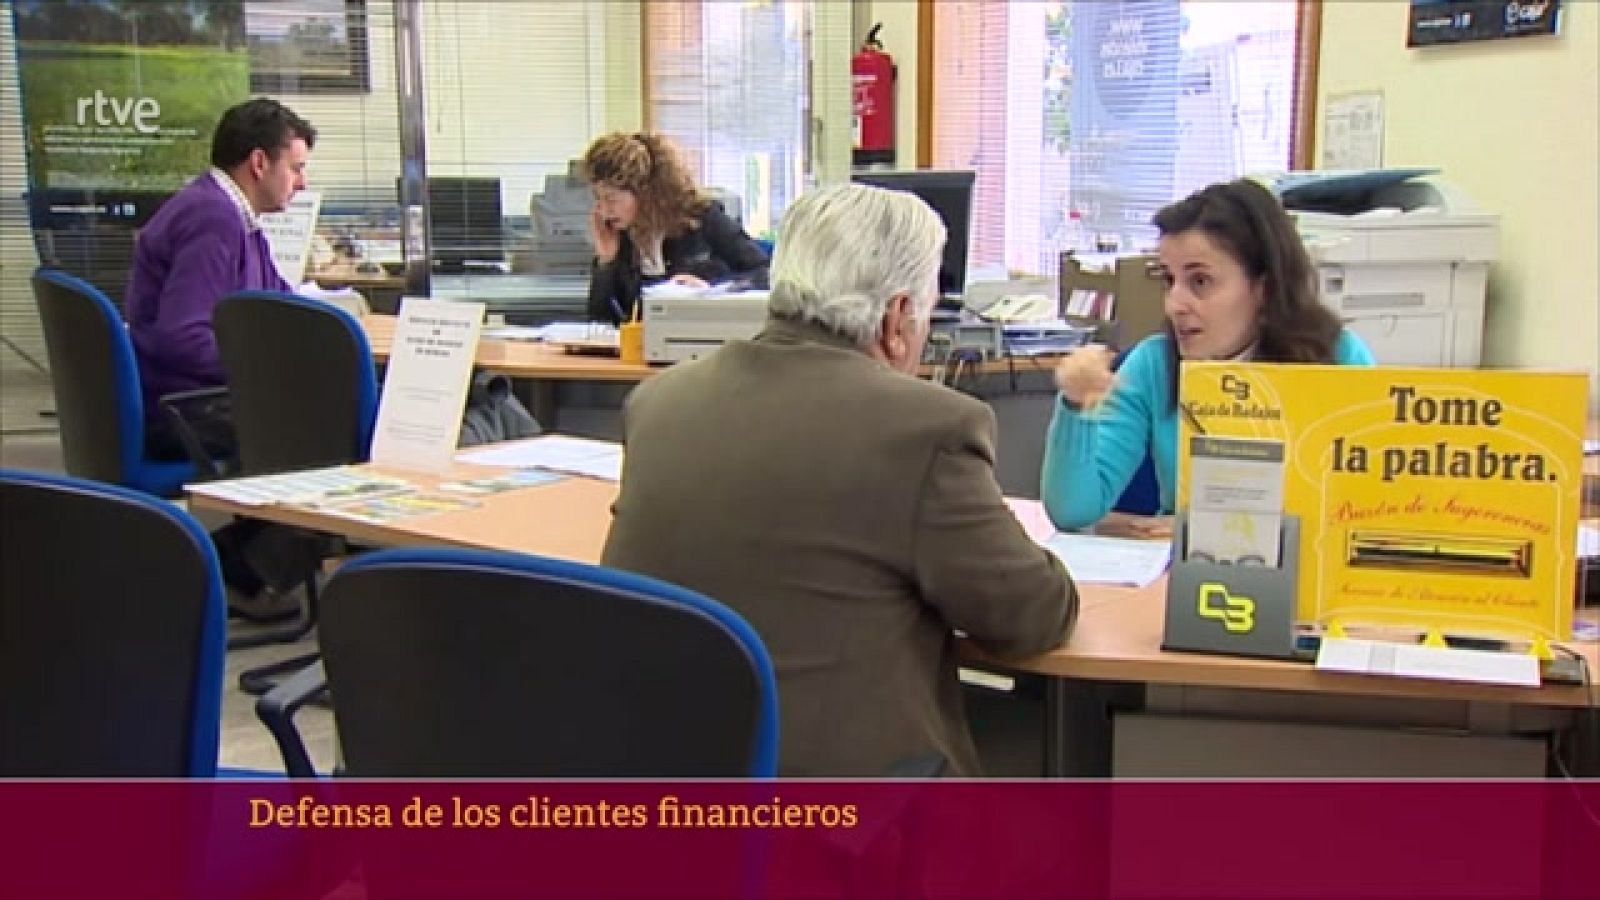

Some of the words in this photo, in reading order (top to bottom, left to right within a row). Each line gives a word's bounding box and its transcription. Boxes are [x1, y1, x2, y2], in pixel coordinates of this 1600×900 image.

[1390, 385, 1503, 427] Tome
[1331, 438, 1369, 474] la
[1382, 442, 1558, 483] palabra.
